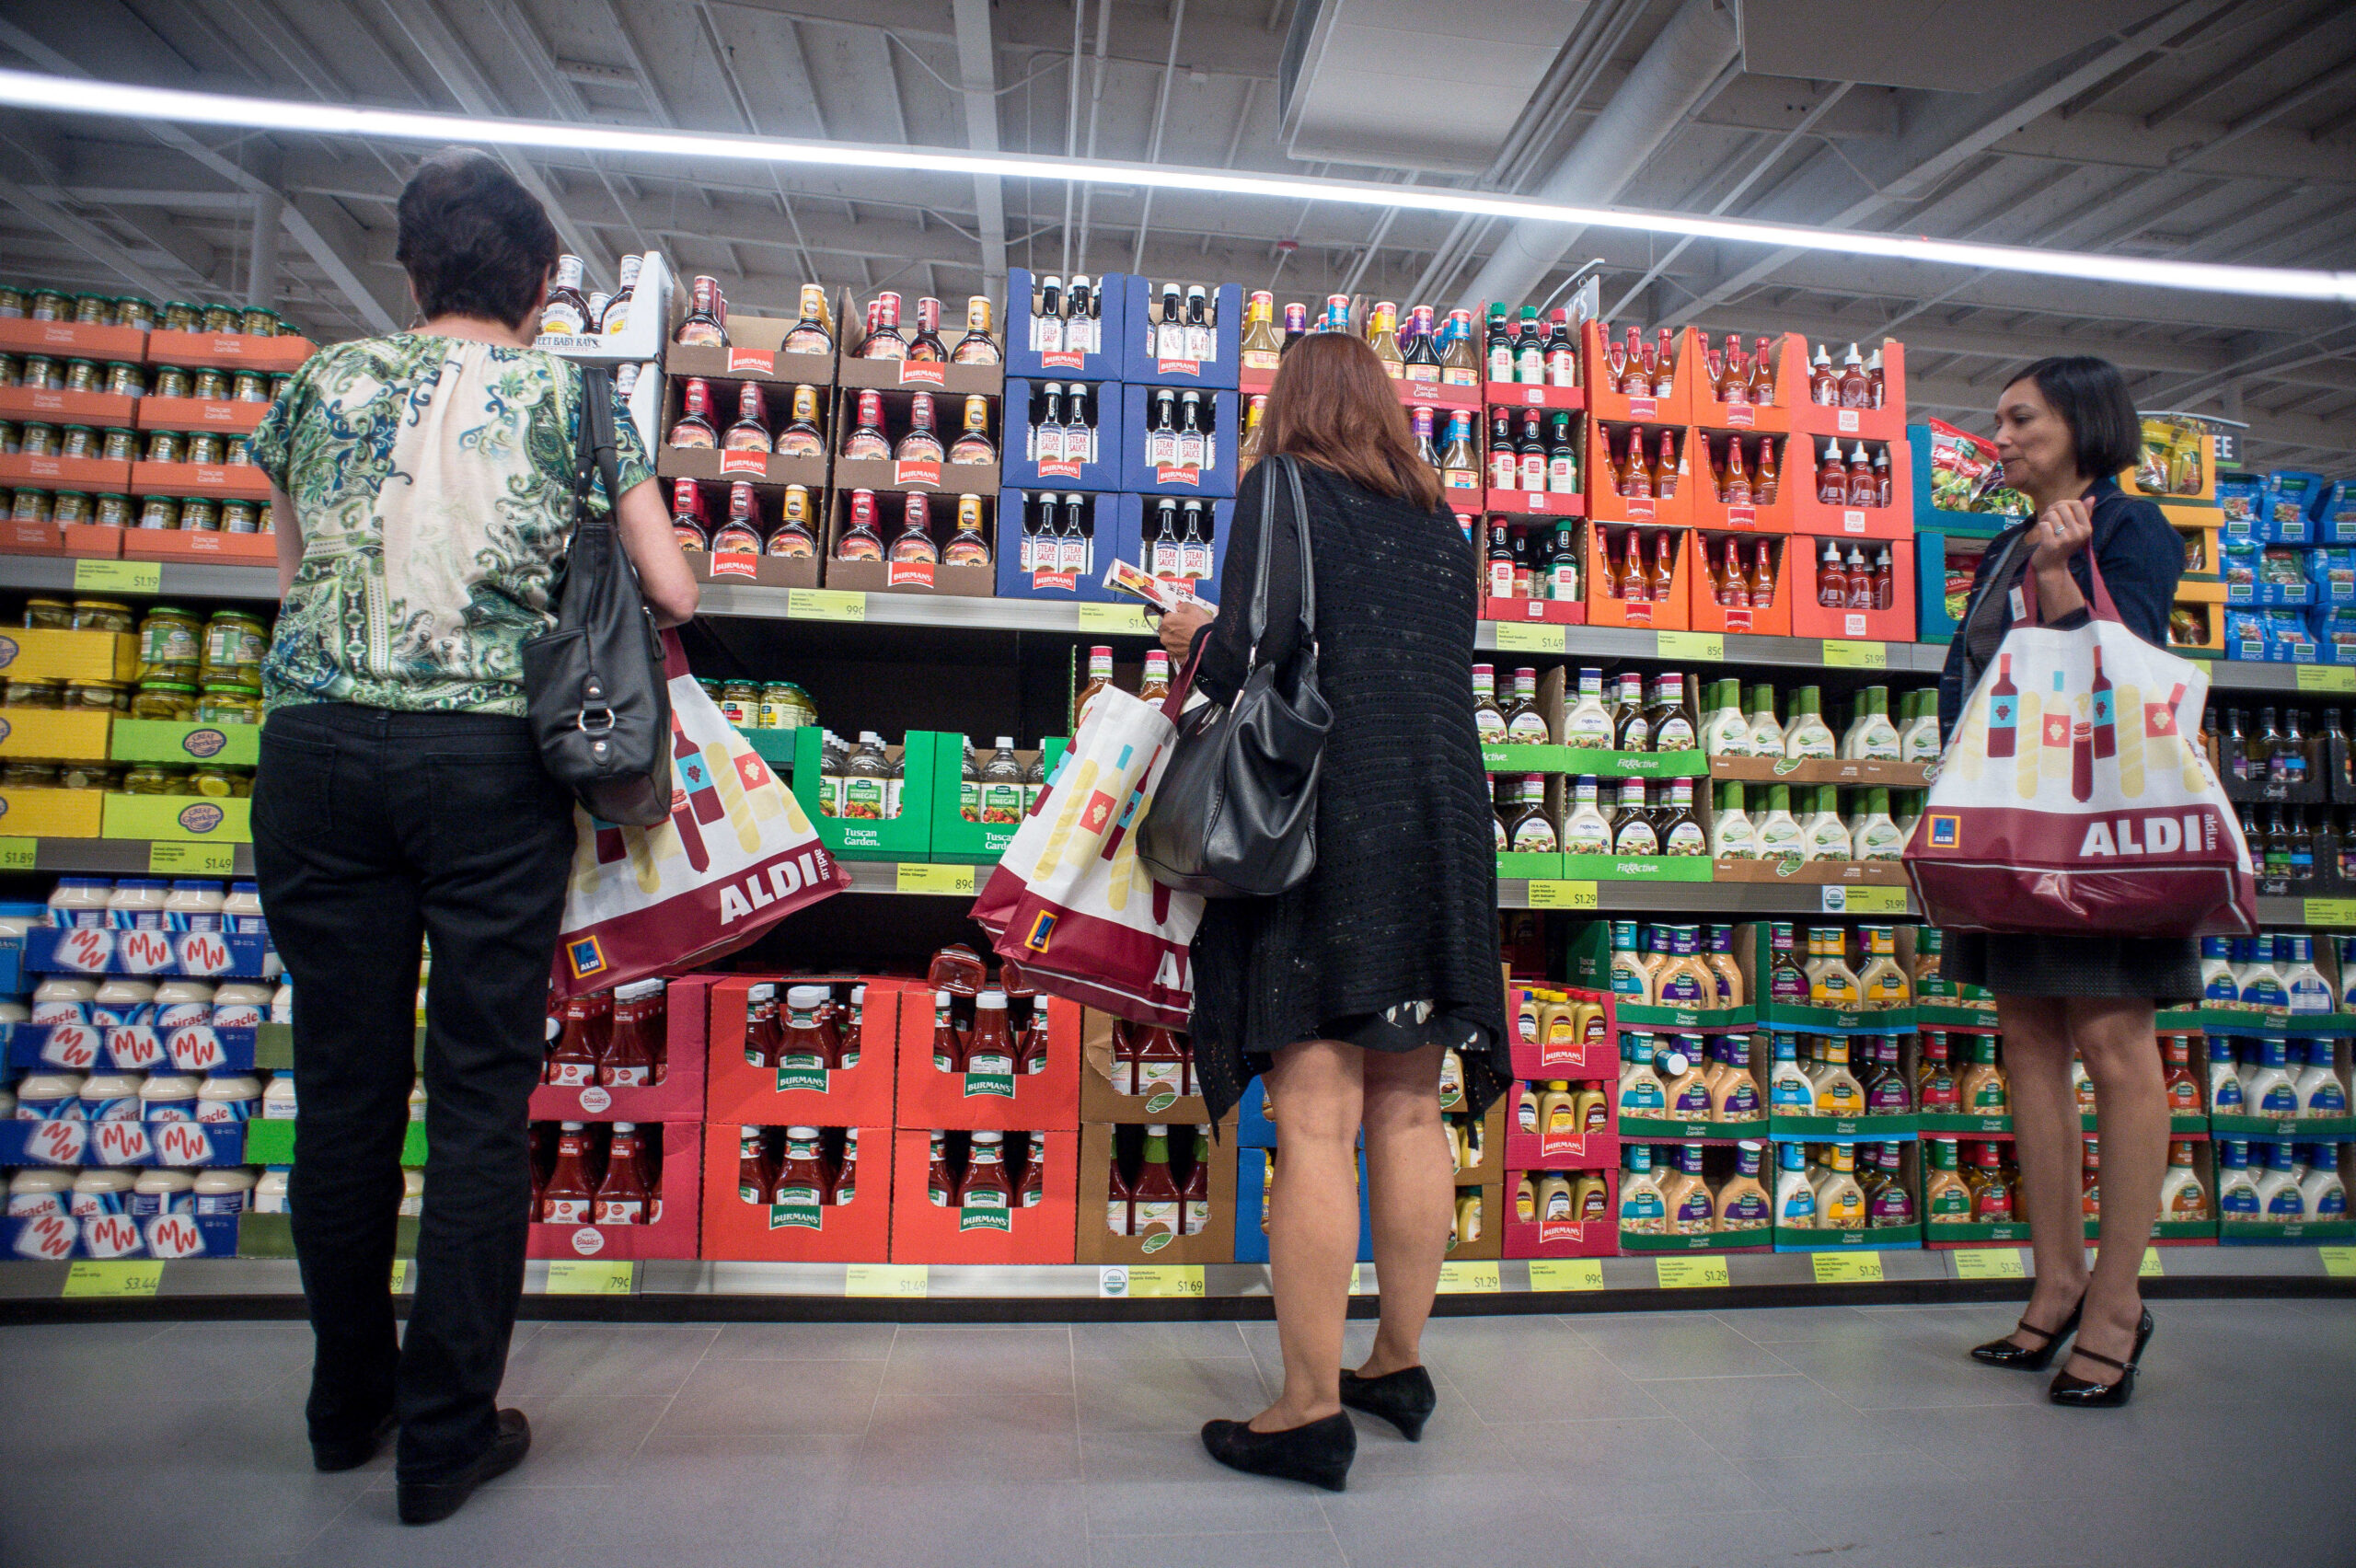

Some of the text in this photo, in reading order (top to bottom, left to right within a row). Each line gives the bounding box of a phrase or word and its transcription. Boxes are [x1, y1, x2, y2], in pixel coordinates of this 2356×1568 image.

[553, 337, 573, 346] BABY
[733, 358, 772, 368] BURMAN'S
[905, 370, 943, 380] BURMAN'S
[1415, 383, 1438, 392] Tuscan
[1068, 435, 1087, 444] STEAK
[1155, 440, 1173, 448] STEAK
[1068, 444, 1087, 452] SAUCE
[1183, 441, 1200, 449] STEAK
[1155, 448, 1173, 457] SAUCE
[1183, 449, 1200, 458] SAUCE
[726, 460, 765, 470] BURMAN'S
[900, 470, 939, 479] BURMAN'S
[1036, 544, 1056, 553] STEAK
[1063, 546, 1081, 554] STEAK
[1036, 552, 1056, 561] SAUCE
[1063, 553, 1081, 562] SAUCE
[1158, 550, 1176, 559] STEAK
[1185, 551, 1203, 559] STEAK
[716, 561, 756, 572] BURMAN'S
[1158, 558, 1176, 567] SAUCE
[1185, 559, 1203, 568] SAUCE
[894, 571, 932, 582] BURMAN'S
[1128, 618, 1150, 628] $1.4
[1542, 638, 1564, 648] $1.49
[1707, 646, 1722, 656] 85¢
[1865, 654, 1885, 664] $1.99
[1482, 752, 1508, 762] Active
[1617, 758, 1658, 769] Fit&Active
[845, 828, 877, 836] Tuscan
[2079, 814, 2202, 857] ALDI
[2203, 813, 2219, 851] aldi.us
[985, 833, 1011, 842] Tusca
[5, 852, 34, 863] $1.89
[205, 858, 231, 869] $1.49
[814, 848, 830, 881] aldi.us
[1617, 863, 1658, 874] Fit&Active
[720, 852, 819, 926] ALDI
[955, 879, 973, 889] 89¢
[1575, 894, 1596, 905] $1.29
[1885, 899, 1905, 909] $1.99
[580, 960, 599, 972] ALDI
[221, 1012, 258, 1026] iracle
[1545, 1052, 1581, 1061] BURMAN'S
[780, 1076, 825, 1087] BURMAN'S
[967, 1081, 1011, 1092] BURMAN'S
[583, 1095, 607, 1104] Basics
[1545, 1140, 1581, 1149] BURMAN'S
[774, 1213, 818, 1224] BURMAN'S
[963, 1215, 1007, 1227] BURMAN'S
[1544, 1227, 1579, 1237] BURMAN'S
[576, 1236, 600, 1246] Basics
[1859, 1264, 1880, 1275] $1.29
[2001, 1262, 2022, 1273] $1.29
[1704, 1270, 1727, 1282] $1.29
[611, 1276, 629, 1288] 79¢
[900, 1280, 926, 1292] $1.49
[1178, 1280, 1203, 1292] $1.69
[1474, 1276, 1497, 1287] $1.29
